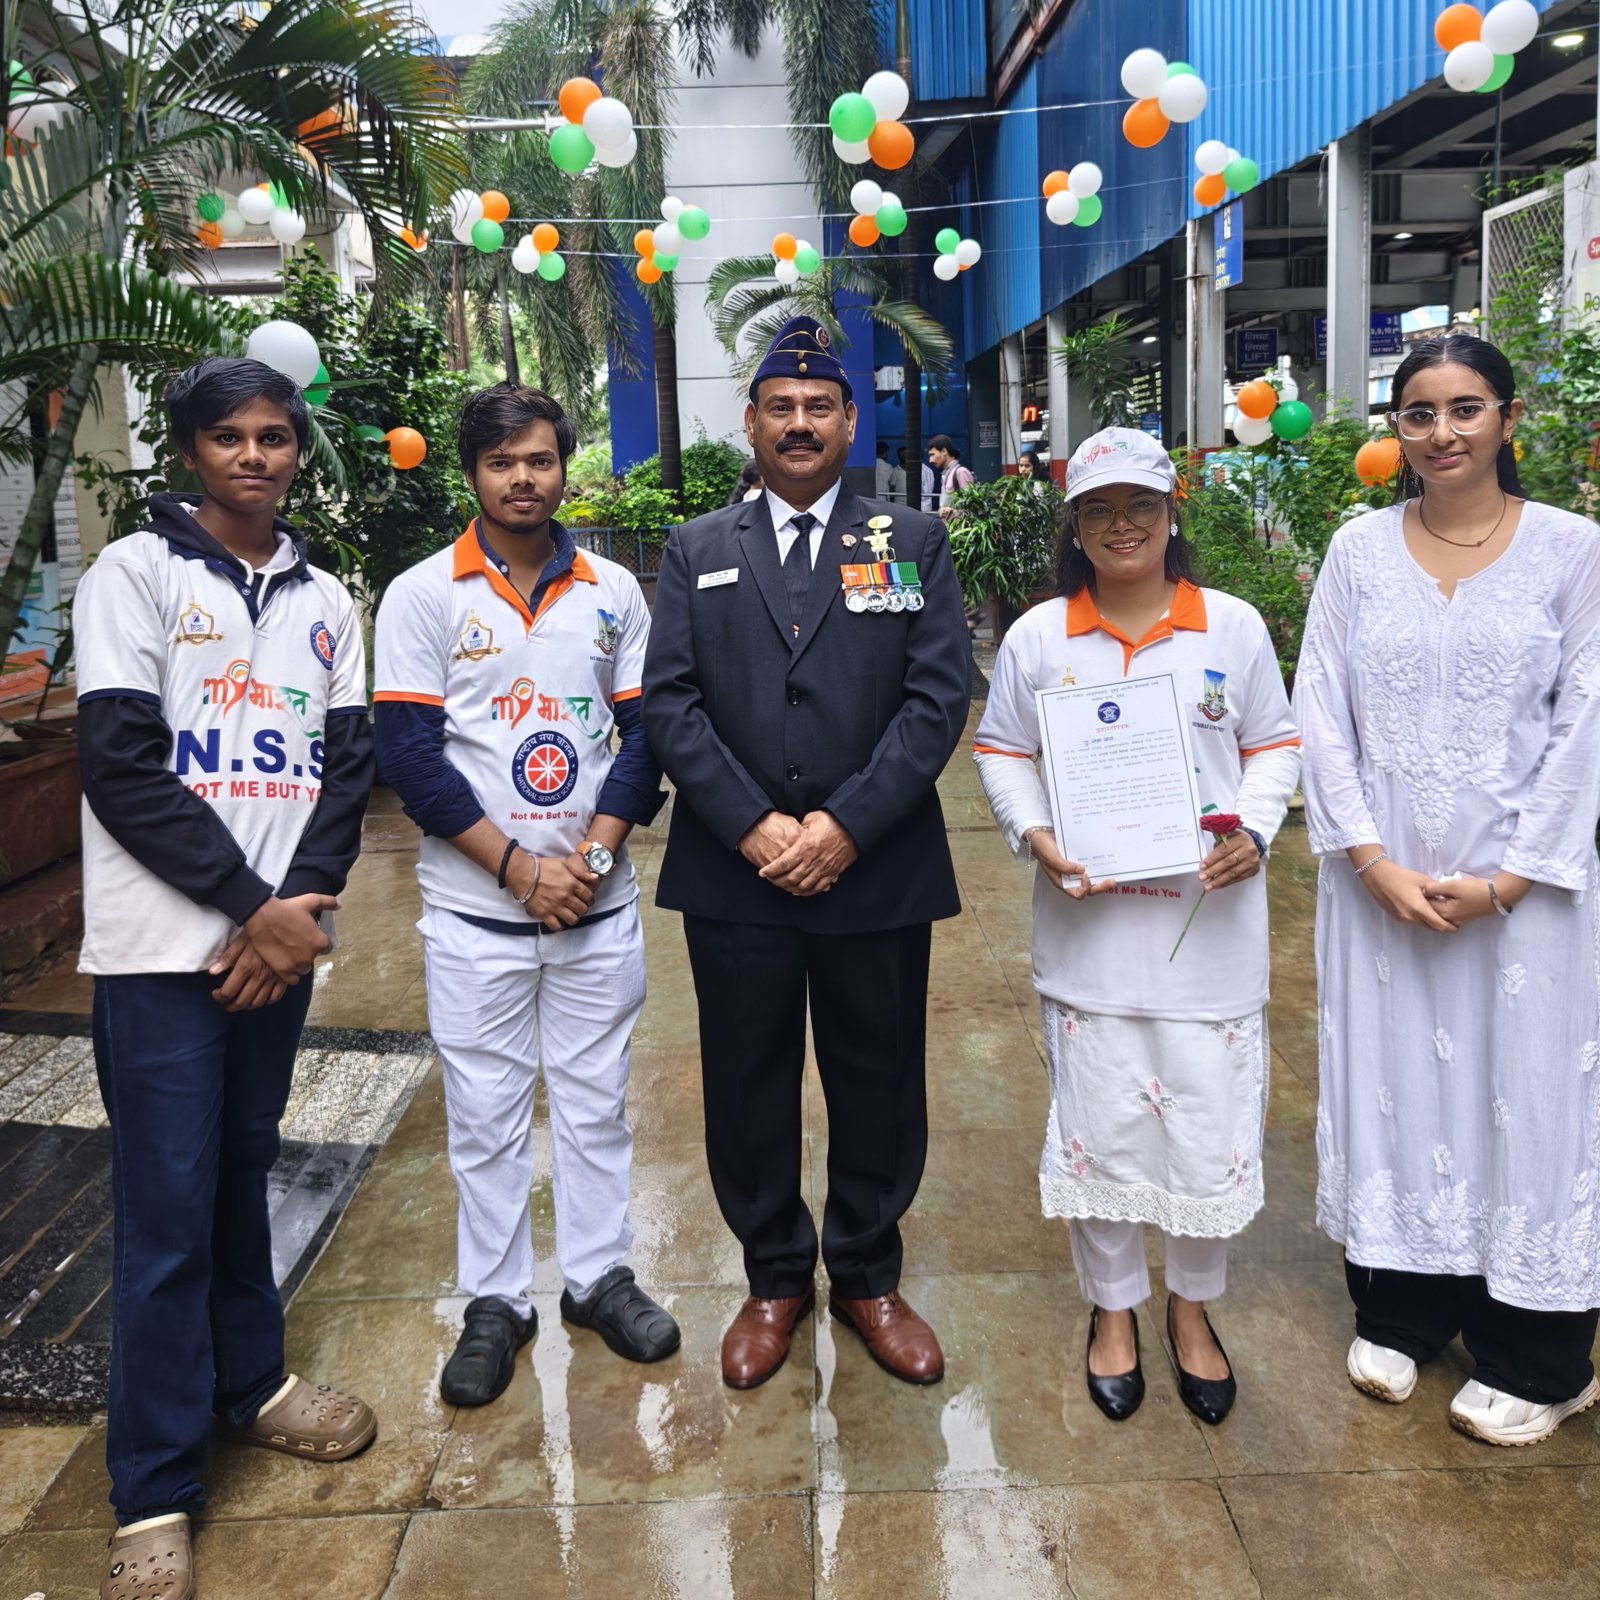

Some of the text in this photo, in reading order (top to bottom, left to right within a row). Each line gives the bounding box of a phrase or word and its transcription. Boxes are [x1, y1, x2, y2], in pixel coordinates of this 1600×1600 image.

[1244, 352, 1270, 362] LIFT
[184, 781, 223, 800] OT
[230, 781, 260, 798] ME
[265, 782, 301, 801] BUT
[516, 773, 577, 803] NATIONAL SERVICE SCHEME
[510, 810, 578, 820] Not Me But You
[1121, 885, 1137, 894] Me
[1140, 886, 1159, 896] But
[1161, 888, 1181, 898] You
